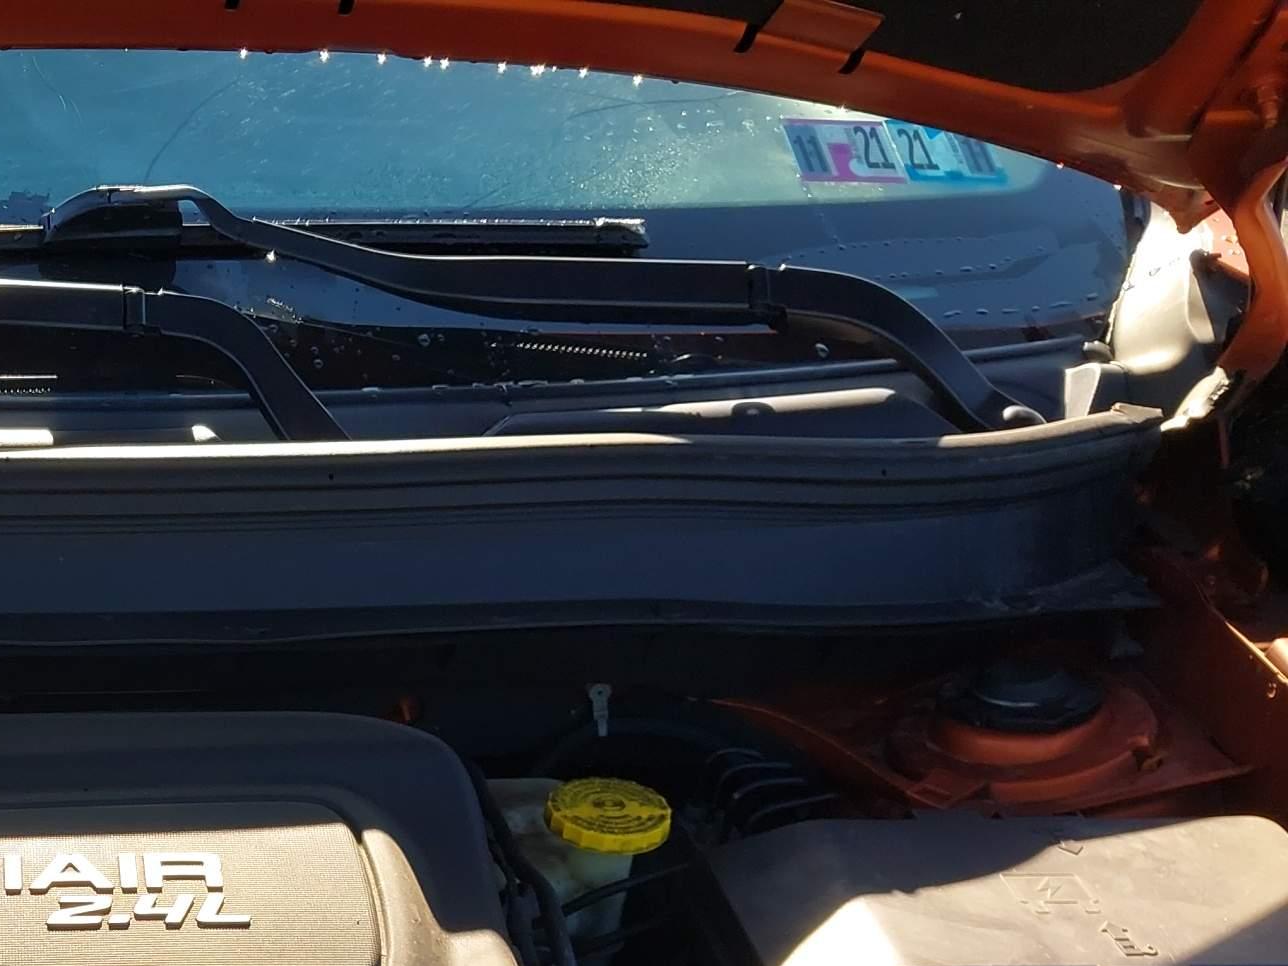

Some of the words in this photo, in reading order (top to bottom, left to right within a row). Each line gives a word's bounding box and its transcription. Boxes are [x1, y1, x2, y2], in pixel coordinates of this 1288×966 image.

[854, 126, 897, 169] 21
[897, 128, 941, 170] 21
[45, 892, 252, 931] 2.4L
